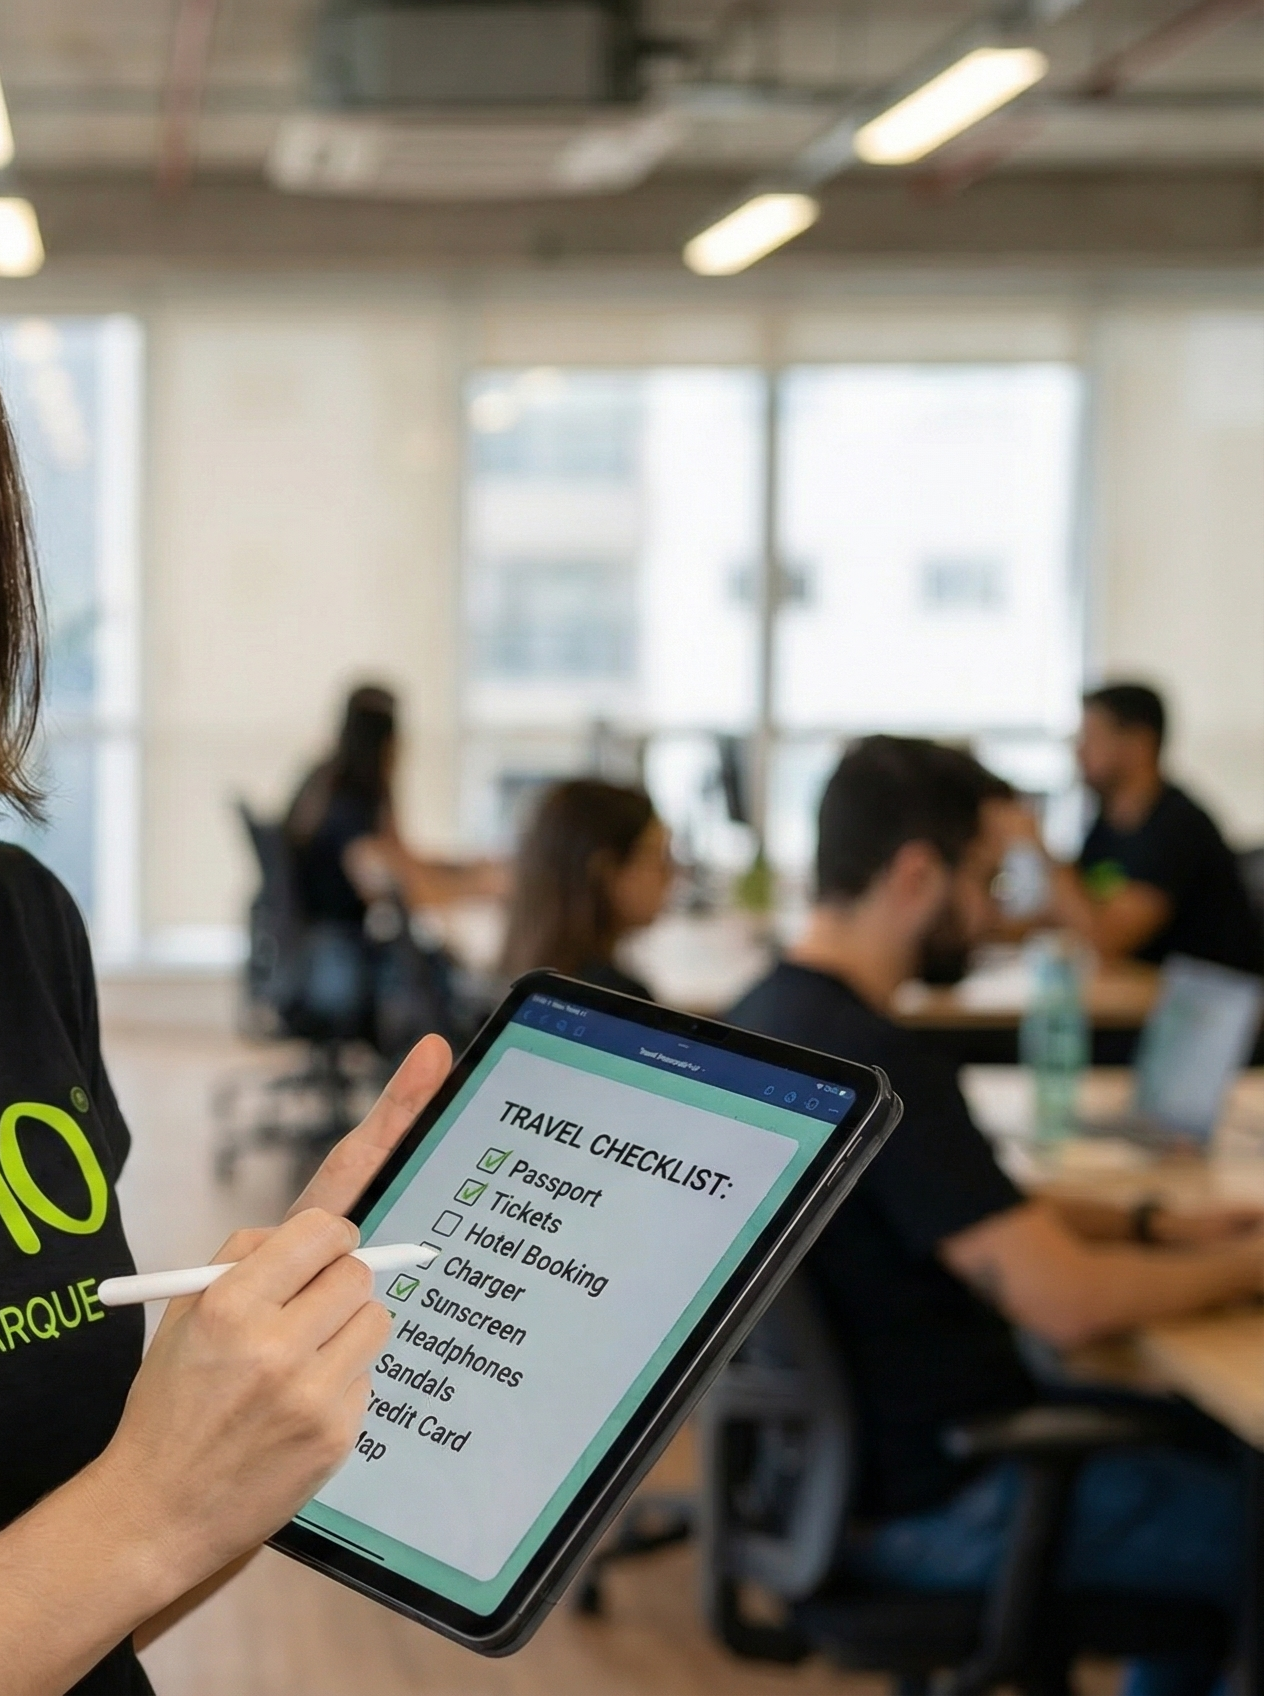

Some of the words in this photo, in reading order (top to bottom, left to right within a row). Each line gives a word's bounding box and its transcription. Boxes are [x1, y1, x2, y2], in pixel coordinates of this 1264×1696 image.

[499, 1101, 584, 1149] TRAVEL
[590, 1134, 733, 1199] CHECKLIST:
[490, 1191, 562, 1234] Tickets
[508, 1160, 602, 1208] Passport
[443, 1257, 526, 1301] Charger
[464, 1222, 525, 1259] Hotel
[521, 1244, 609, 1297] Booking
[421, 1288, 527, 1346] Sunscreen
[375, 1353, 455, 1402] Sandals
[397, 1320, 524, 1387] Headphones
[367, 1389, 418, 1429] redit
[418, 1415, 472, 1452] Card
